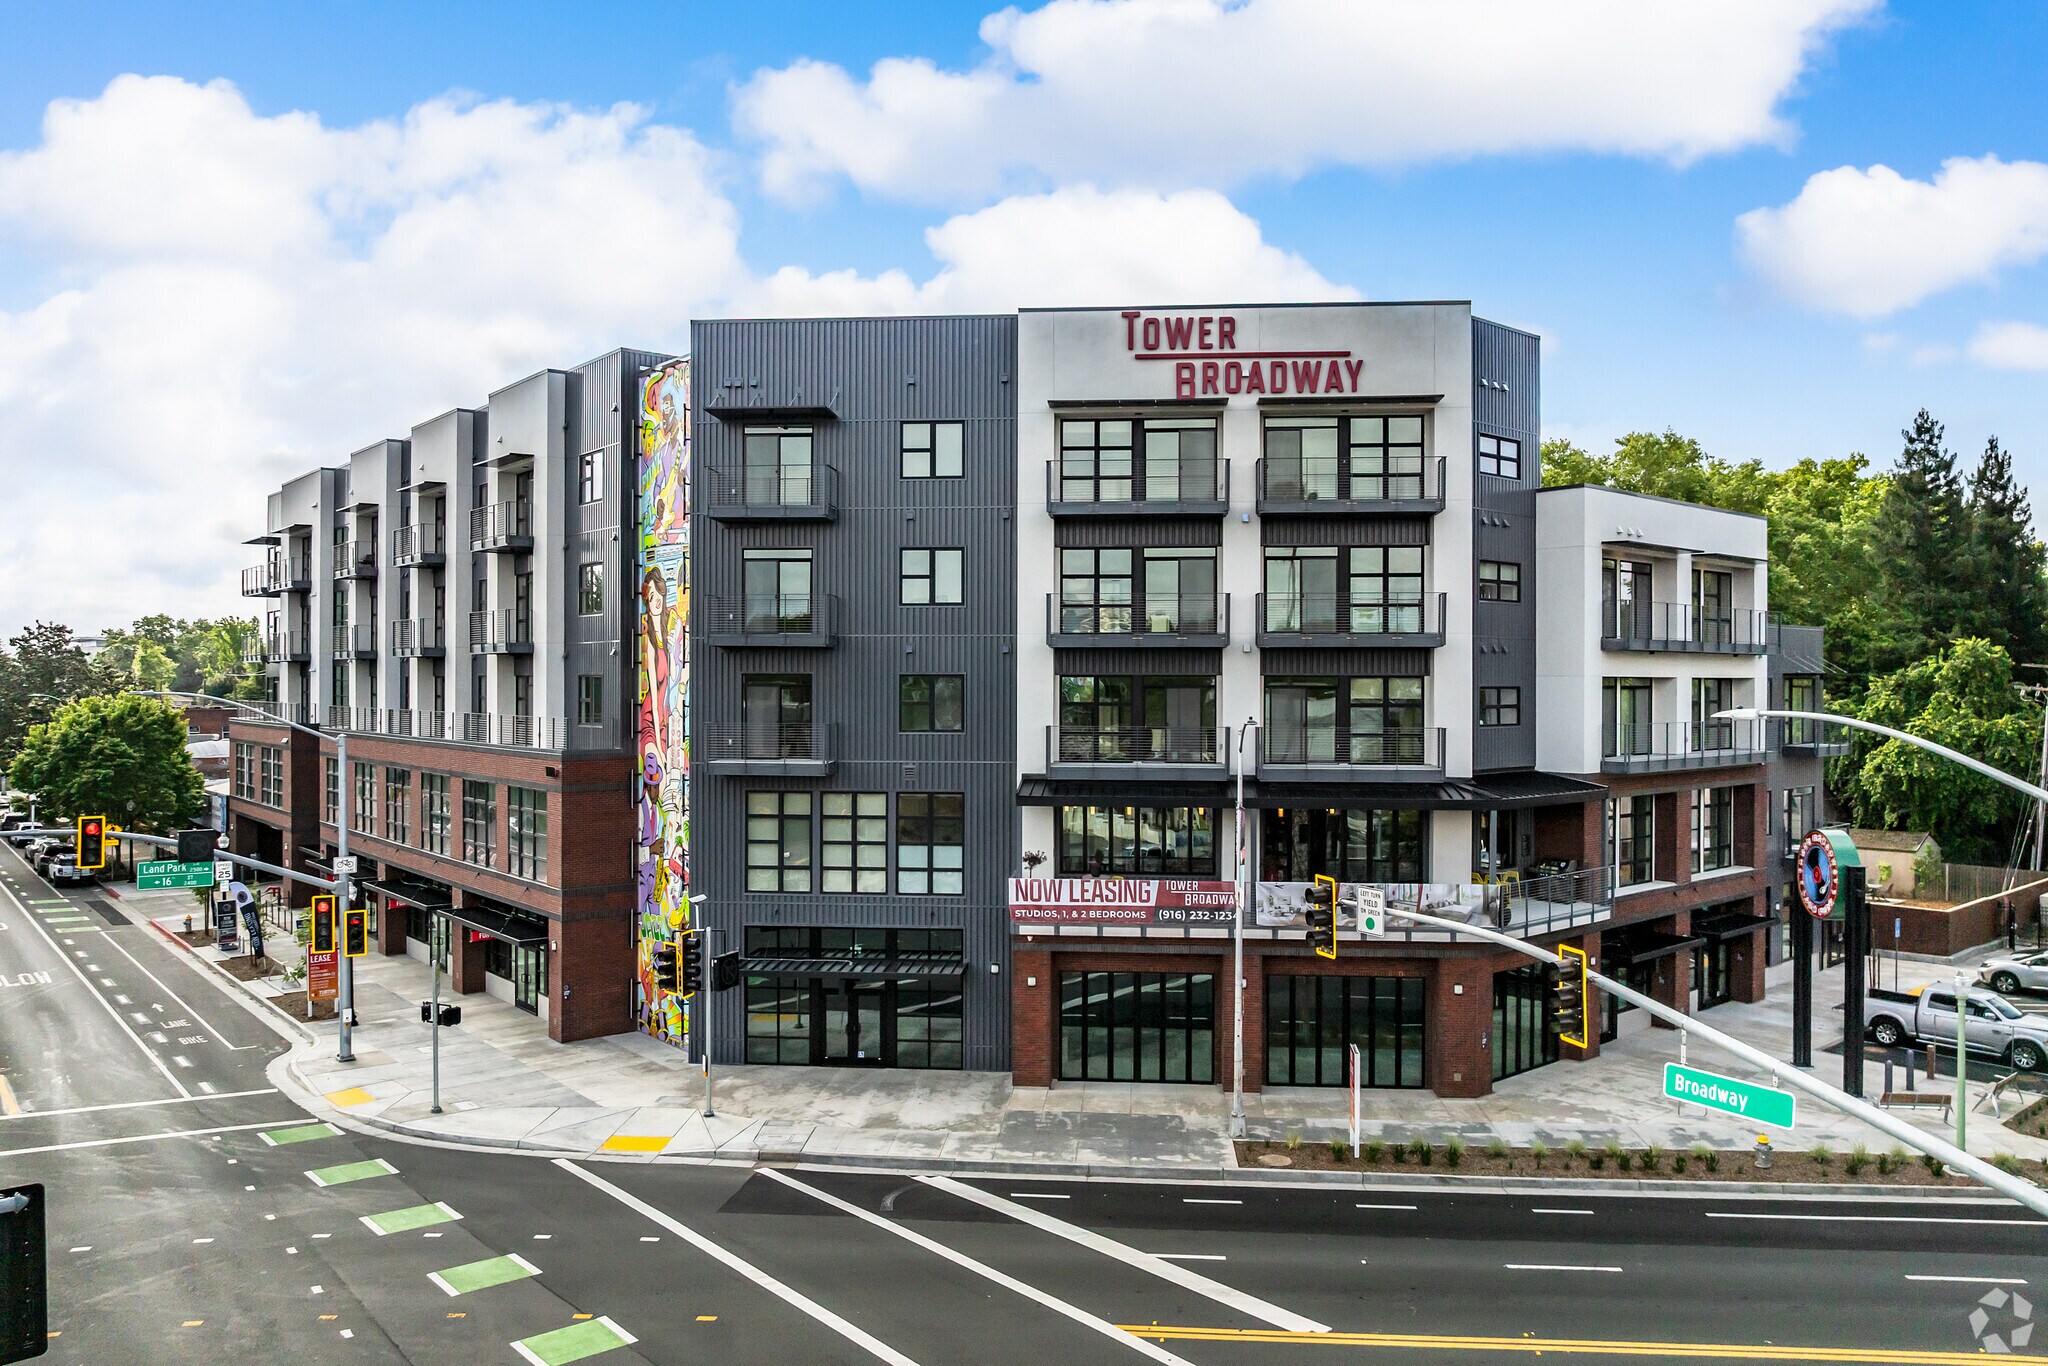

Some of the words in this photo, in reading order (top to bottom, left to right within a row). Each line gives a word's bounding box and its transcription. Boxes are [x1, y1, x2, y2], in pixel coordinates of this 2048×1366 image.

[1121, 311, 1237, 350] TOWER
[1176, 359, 1363, 399] BROADWAY
[143, 864, 165, 874] Land
[167, 863, 187, 873] Park
[218, 870, 231, 878] 25
[162, 877, 172, 886] 16
[1165, 880, 1198, 891] TOWER
[1015, 879, 1063, 903] NOW
[1070, 879, 1151, 903] LEASING
[1184, 894, 1235, 906] BROADWA
[1363, 899, 1378, 908] YIELD
[1015, 909, 1060, 919] STUDIOS,
[1062, 910, 1070, 919] 1,
[1072, 910, 1079, 918] &
[1081, 910, 1087, 918] 2
[1089, 910, 1146, 919] BEDROOMS
[1158, 909, 1186, 921] (916)
[641, 912, 666, 942] JAZZ
[310, 953, 331, 963] LEASE
[0, 971, 53, 987] LOW
[160, 1019, 191, 1029] LANE
[178, 1035, 208, 1045] BIKE
[1674, 1073, 1748, 1112] Broadway
